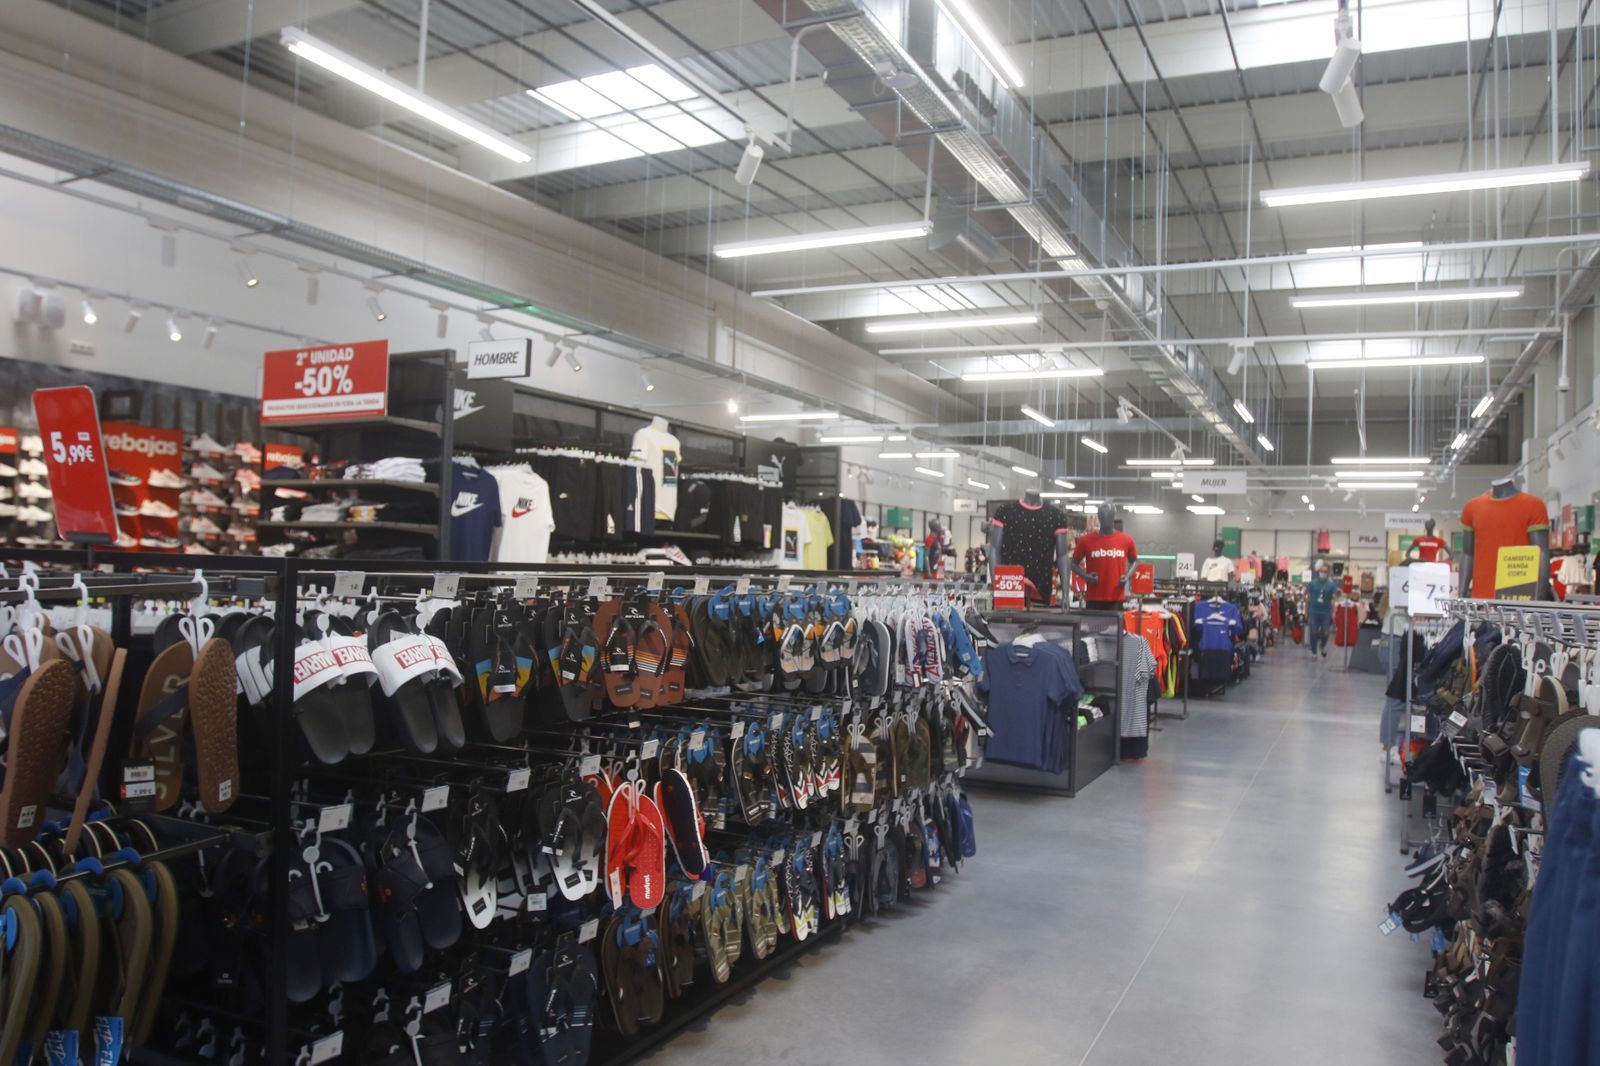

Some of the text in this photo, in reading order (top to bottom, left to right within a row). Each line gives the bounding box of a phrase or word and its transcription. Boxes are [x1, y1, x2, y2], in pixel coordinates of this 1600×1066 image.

[310, 347, 354, 365] UNIDAD
[474, 351, 519, 366] HOMBRE
[294, 364, 353, 396] -50%
[50, 431, 95, 466] 5,99€
[1200, 479, 1227, 487] MUJER
[455, 491, 479, 506] NIKE
[516, 497, 533, 509] NIKE
[1091, 548, 1125, 558] rebajas
[995, 580, 1022, 590] -50%
[643, 874, 651, 899] mistral
